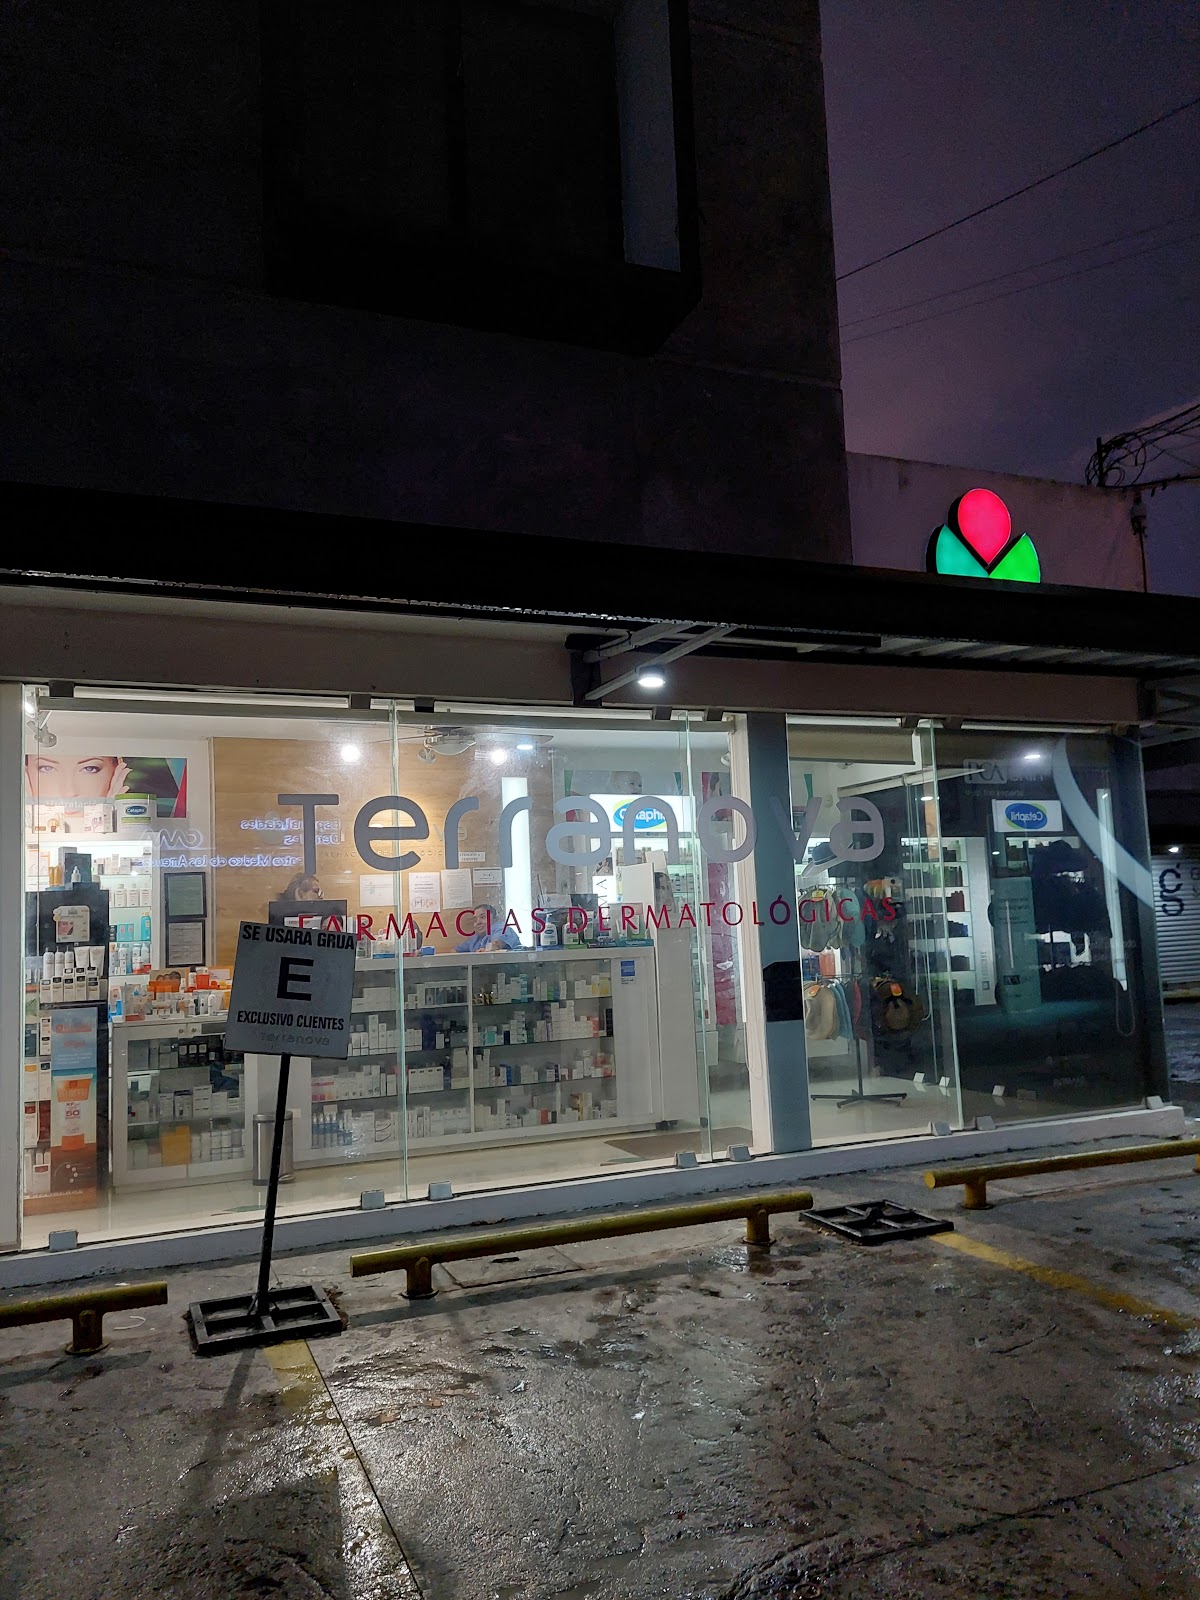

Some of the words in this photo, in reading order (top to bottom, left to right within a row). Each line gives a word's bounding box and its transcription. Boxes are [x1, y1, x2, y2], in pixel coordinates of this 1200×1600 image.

[277, 793, 885, 872] Terranova
[568, 895, 897, 934] DERMATOLÓGICAS
[242, 924, 261, 941] SE
[265, 927, 313, 946] USARA
[317, 932, 355, 950] GRUA
[276, 956, 315, 1001] E
[237, 1010, 294, 1027] EXCLUSIVO
[296, 1014, 345, 1031] CLIENTES
